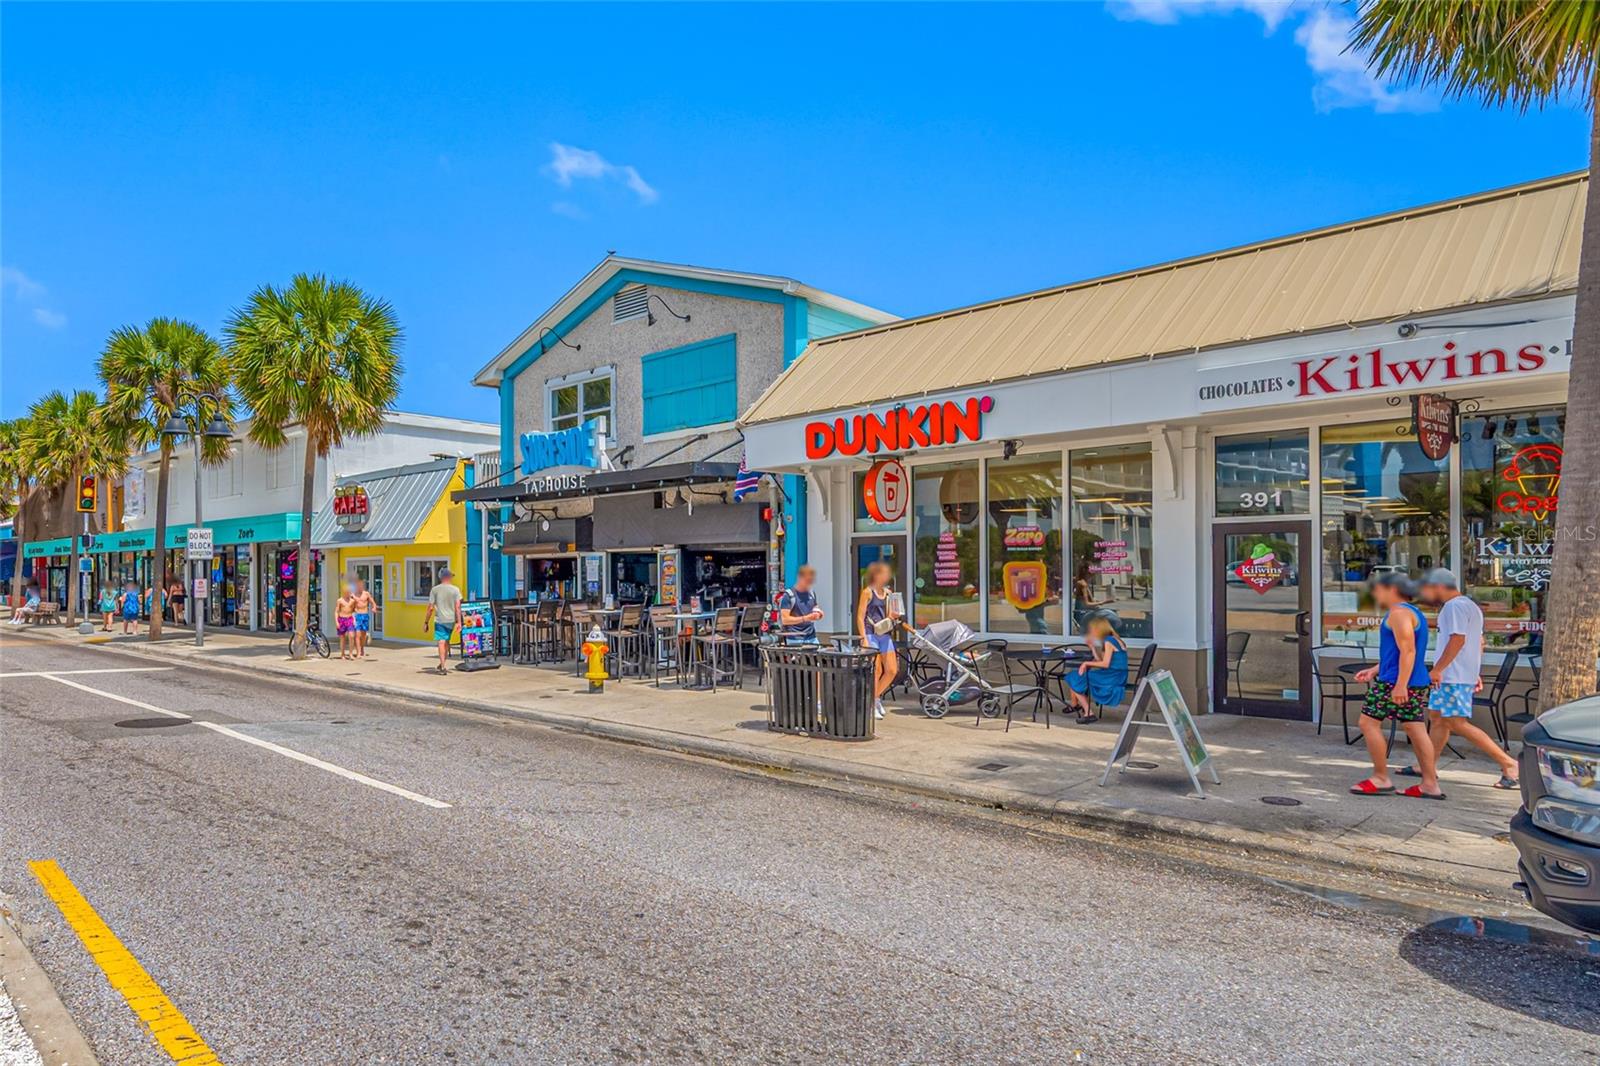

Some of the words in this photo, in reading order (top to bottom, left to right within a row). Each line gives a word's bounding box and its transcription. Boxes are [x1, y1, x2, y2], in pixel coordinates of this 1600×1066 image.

[1199, 377, 1283, 400] CHOCOLATES
[1293, 341, 1545, 397] Kilwins
[805, 396, 994, 459] DUNKIN'
[521, 420, 597, 475] SURFSIDE
[523, 475, 587, 494] TAPHOUSE
[1240, 488, 1281, 508] 391
[1497, 491, 1558, 515] Ope
[190, 532, 199, 540] DO
[200, 532, 211, 540] NOT
[238, 529, 254, 539] Zoe's
[1004, 528, 1046, 547] Zero
[1476, 536, 1554, 556] Kilw
[1242, 565, 1282, 574] Kilwins
